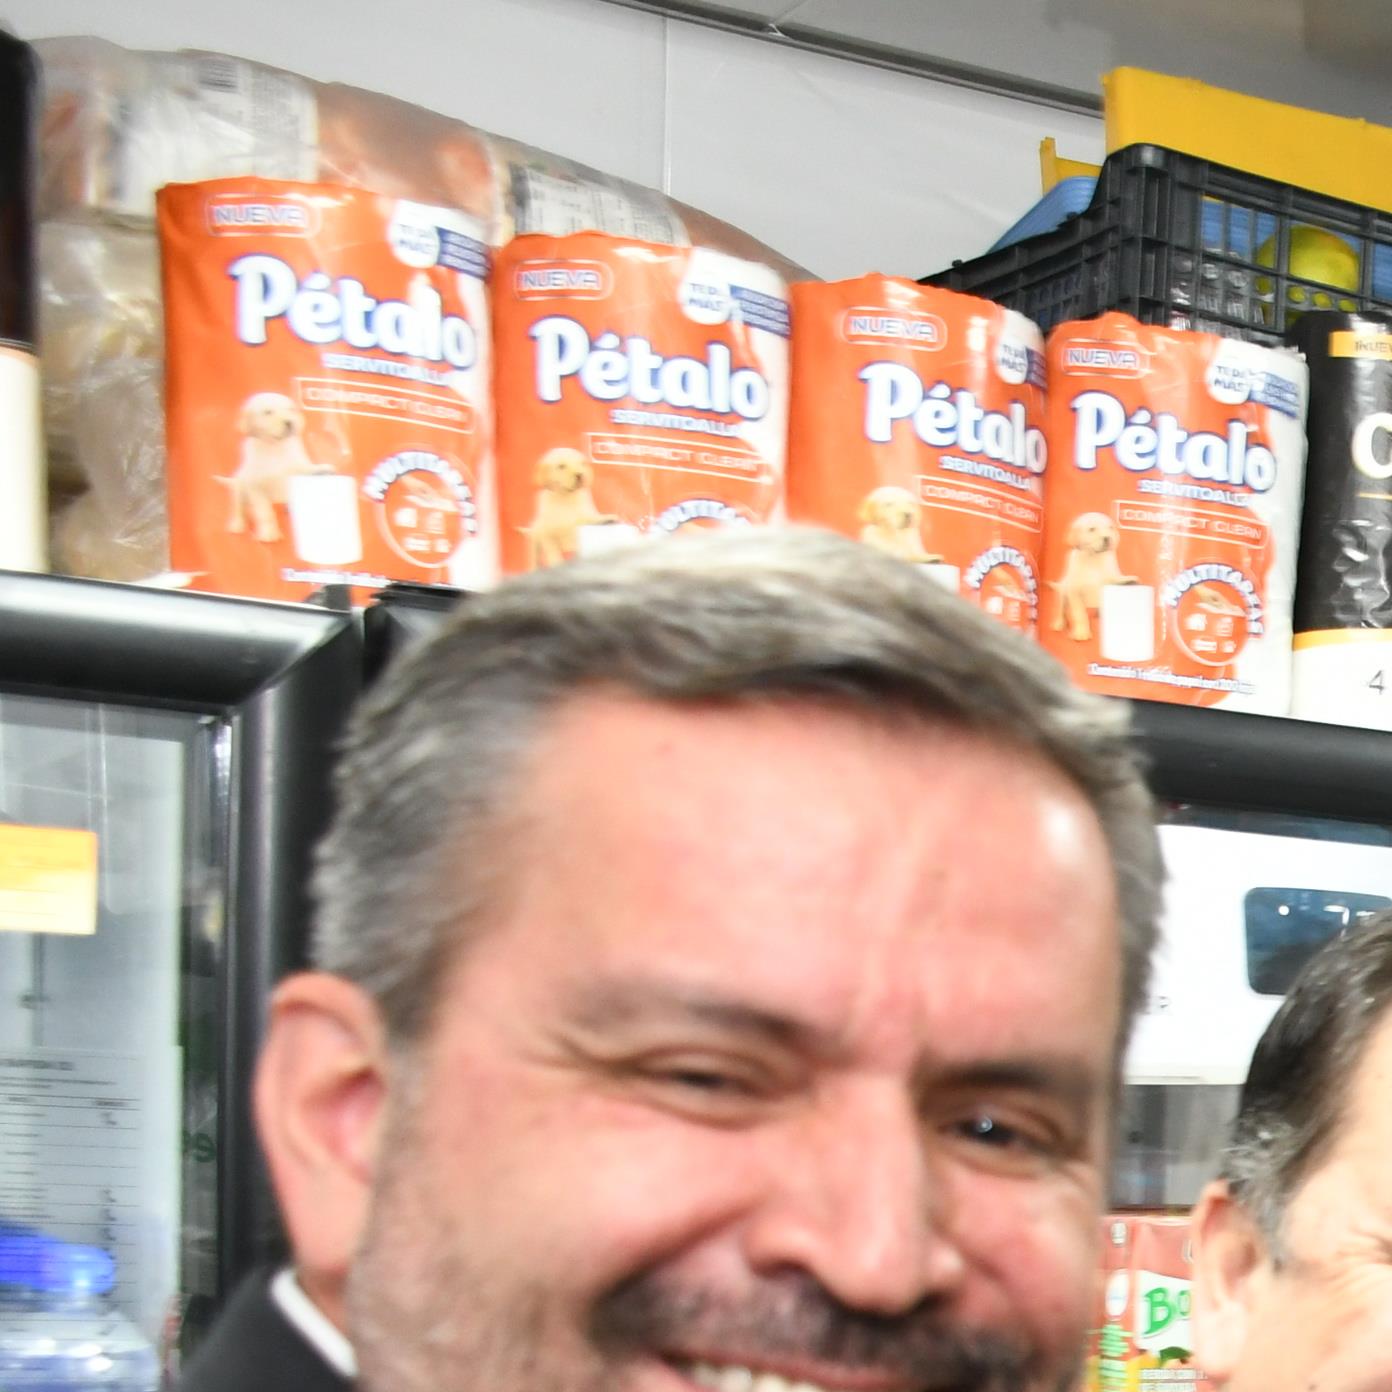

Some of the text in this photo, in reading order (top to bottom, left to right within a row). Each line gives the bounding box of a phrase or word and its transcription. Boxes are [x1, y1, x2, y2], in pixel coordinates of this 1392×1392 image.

[213, 204, 305, 226] NUEVA
[519, 270, 601, 291] NUEVA
[227, 253, 476, 370] Pétalo
[851, 316, 937, 342] NUEVA
[529, 314, 768, 421] Pétalo
[1065, 347, 1139, 370] NUEVA
[858, 361, 1048, 474] Pétalo
[1071, 390, 1277, 494] Pétalo
[1367, 669, 1385, 695] 4
